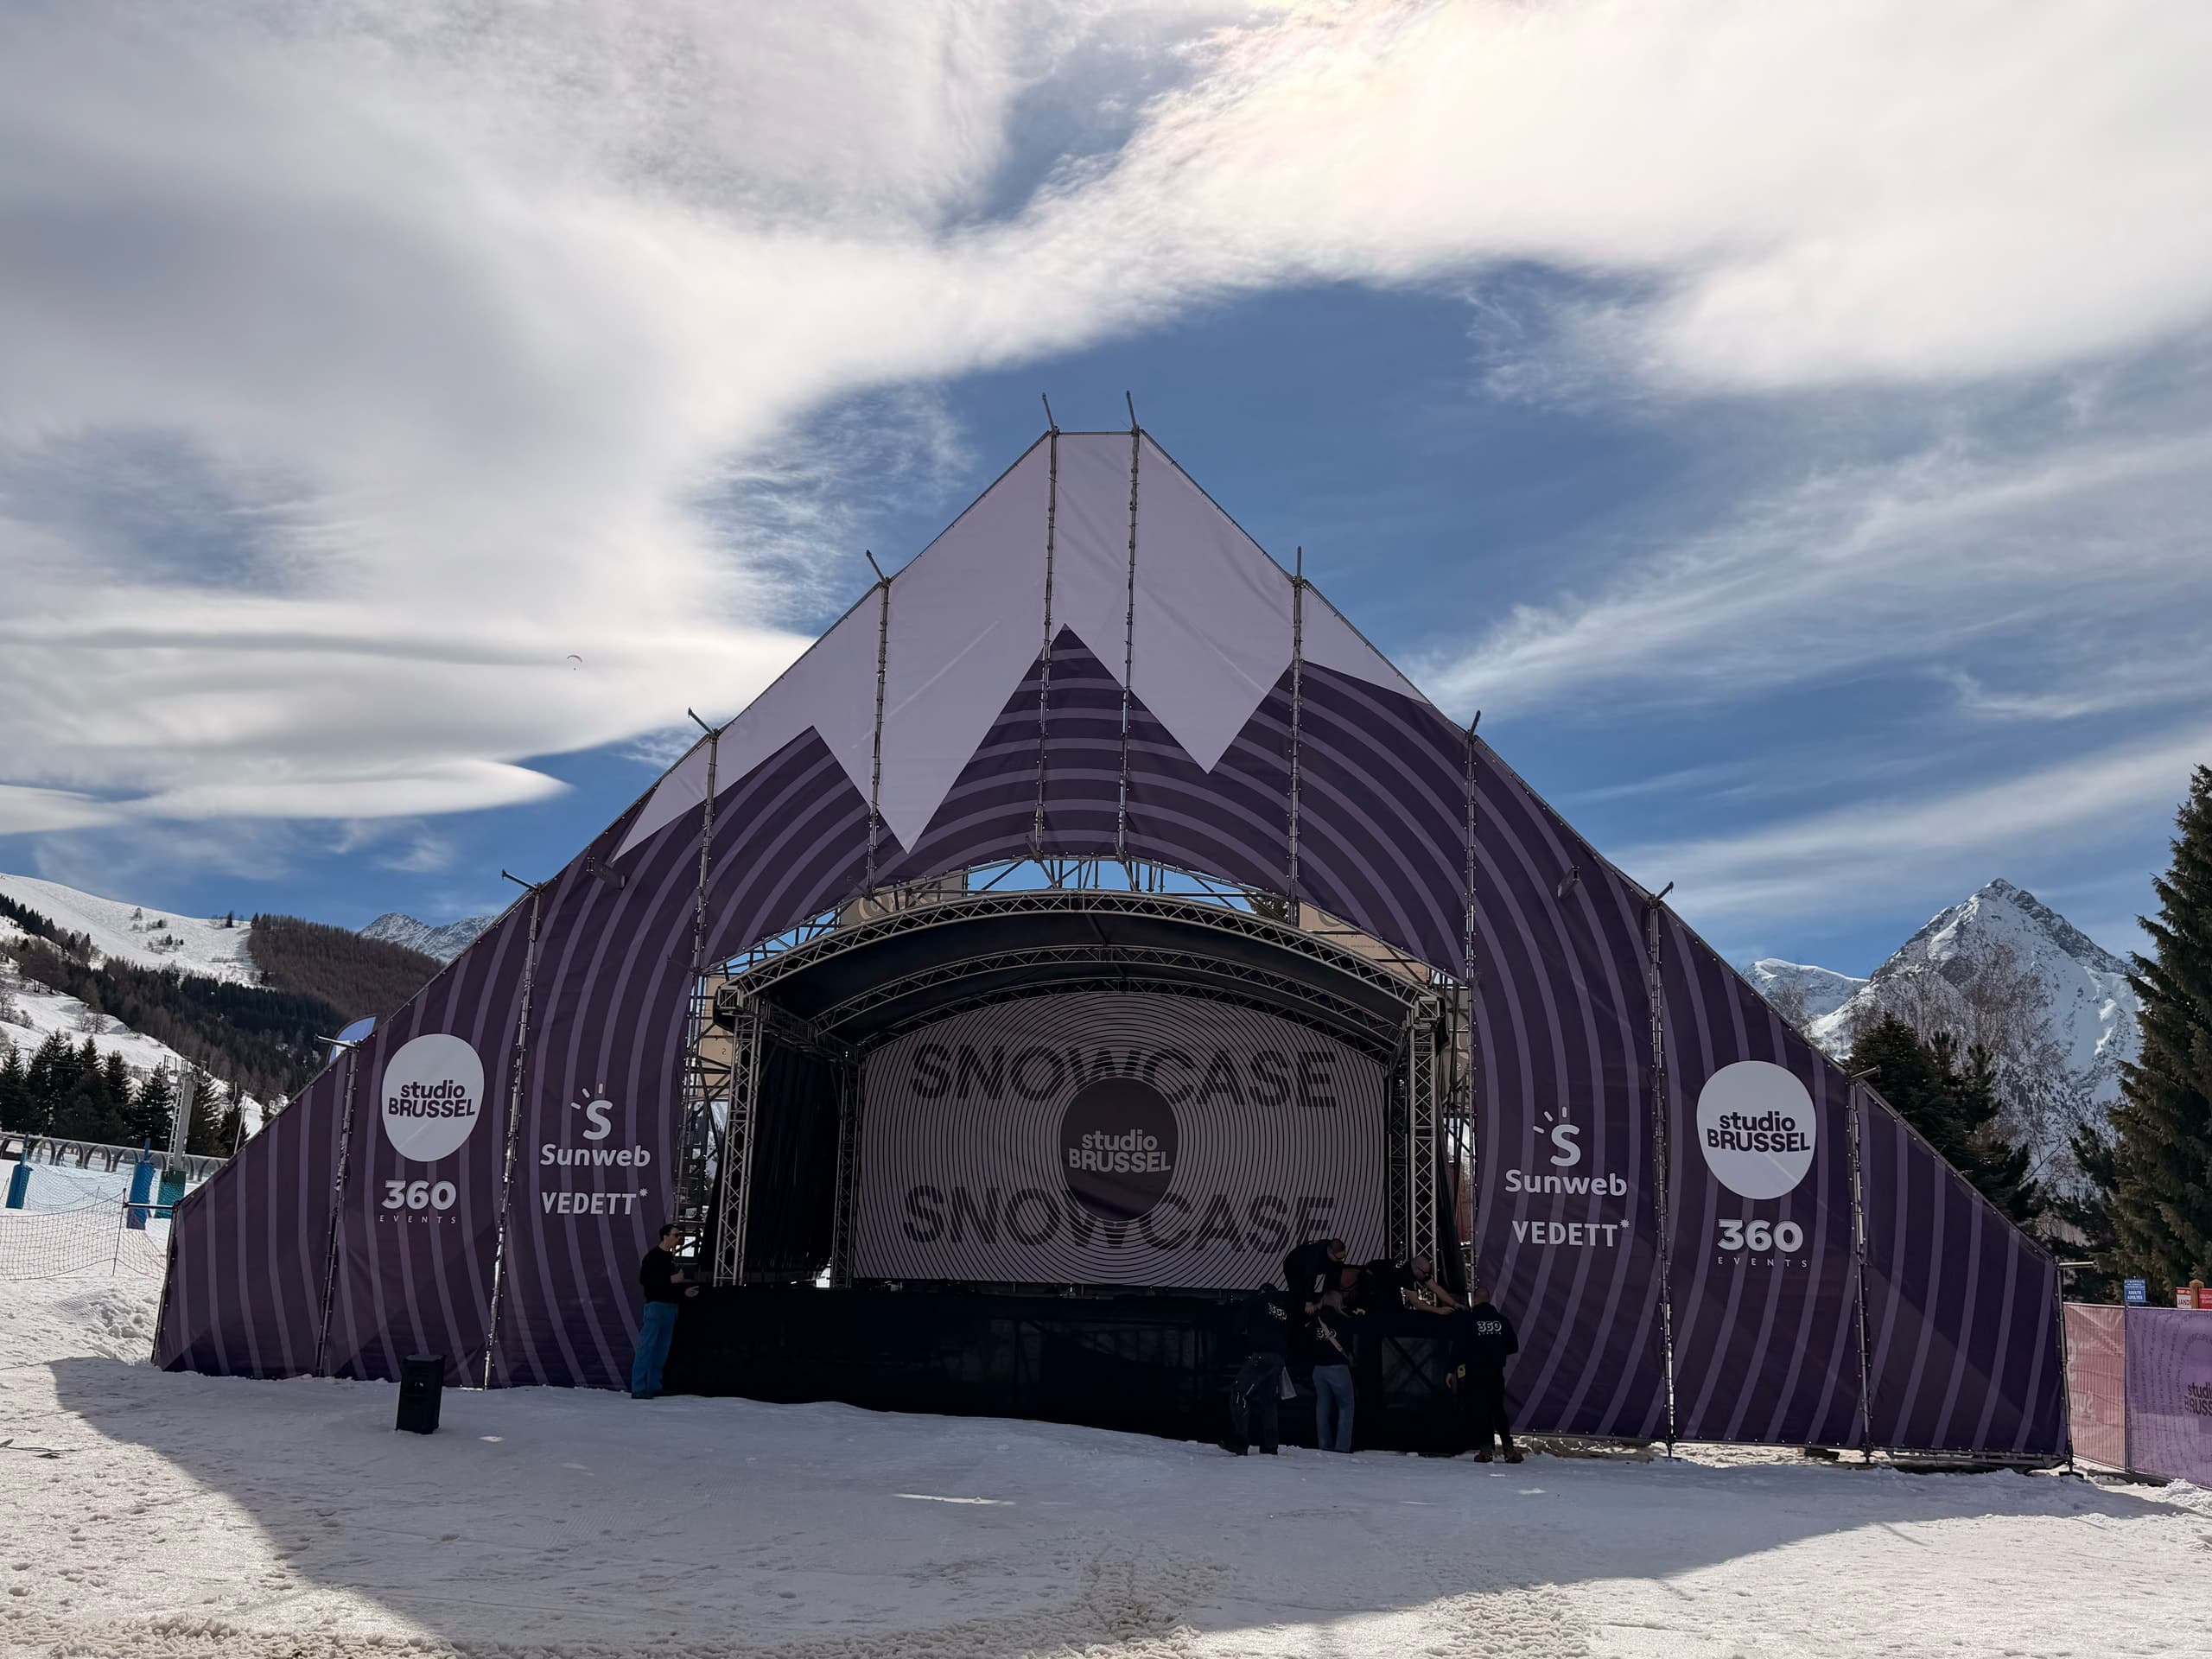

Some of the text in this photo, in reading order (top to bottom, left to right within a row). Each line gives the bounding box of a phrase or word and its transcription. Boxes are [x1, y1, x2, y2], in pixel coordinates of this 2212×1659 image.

[400, 1080, 465, 1099] studio
[388, 1098, 475, 1118] BRUSSEL
[1719, 1111, 1796, 1132] studio
[1081, 1129, 1158, 1151] studio
[1707, 1128, 1810, 1153] BRUSSEL
[540, 1144, 651, 1167] Sunweb
[1069, 1147, 1171, 1173] BRUSSEL
[1505, 1169, 1627, 1197] Sunweb
[381, 1180, 456, 1211] 360
[542, 1192, 637, 1215] VEDETT
[379, 1215, 456, 1224] EVENTS
[1512, 1220, 1618, 1247] VEDETT
[1717, 1219, 1803, 1252] 360
[1718, 1256, 1808, 1268] EVENTS
[1477, 1320, 1502, 1332] 360
[2187, 1382, 2212, 1399] studi
[2184, 1395, 2212, 1417] BRUSS
